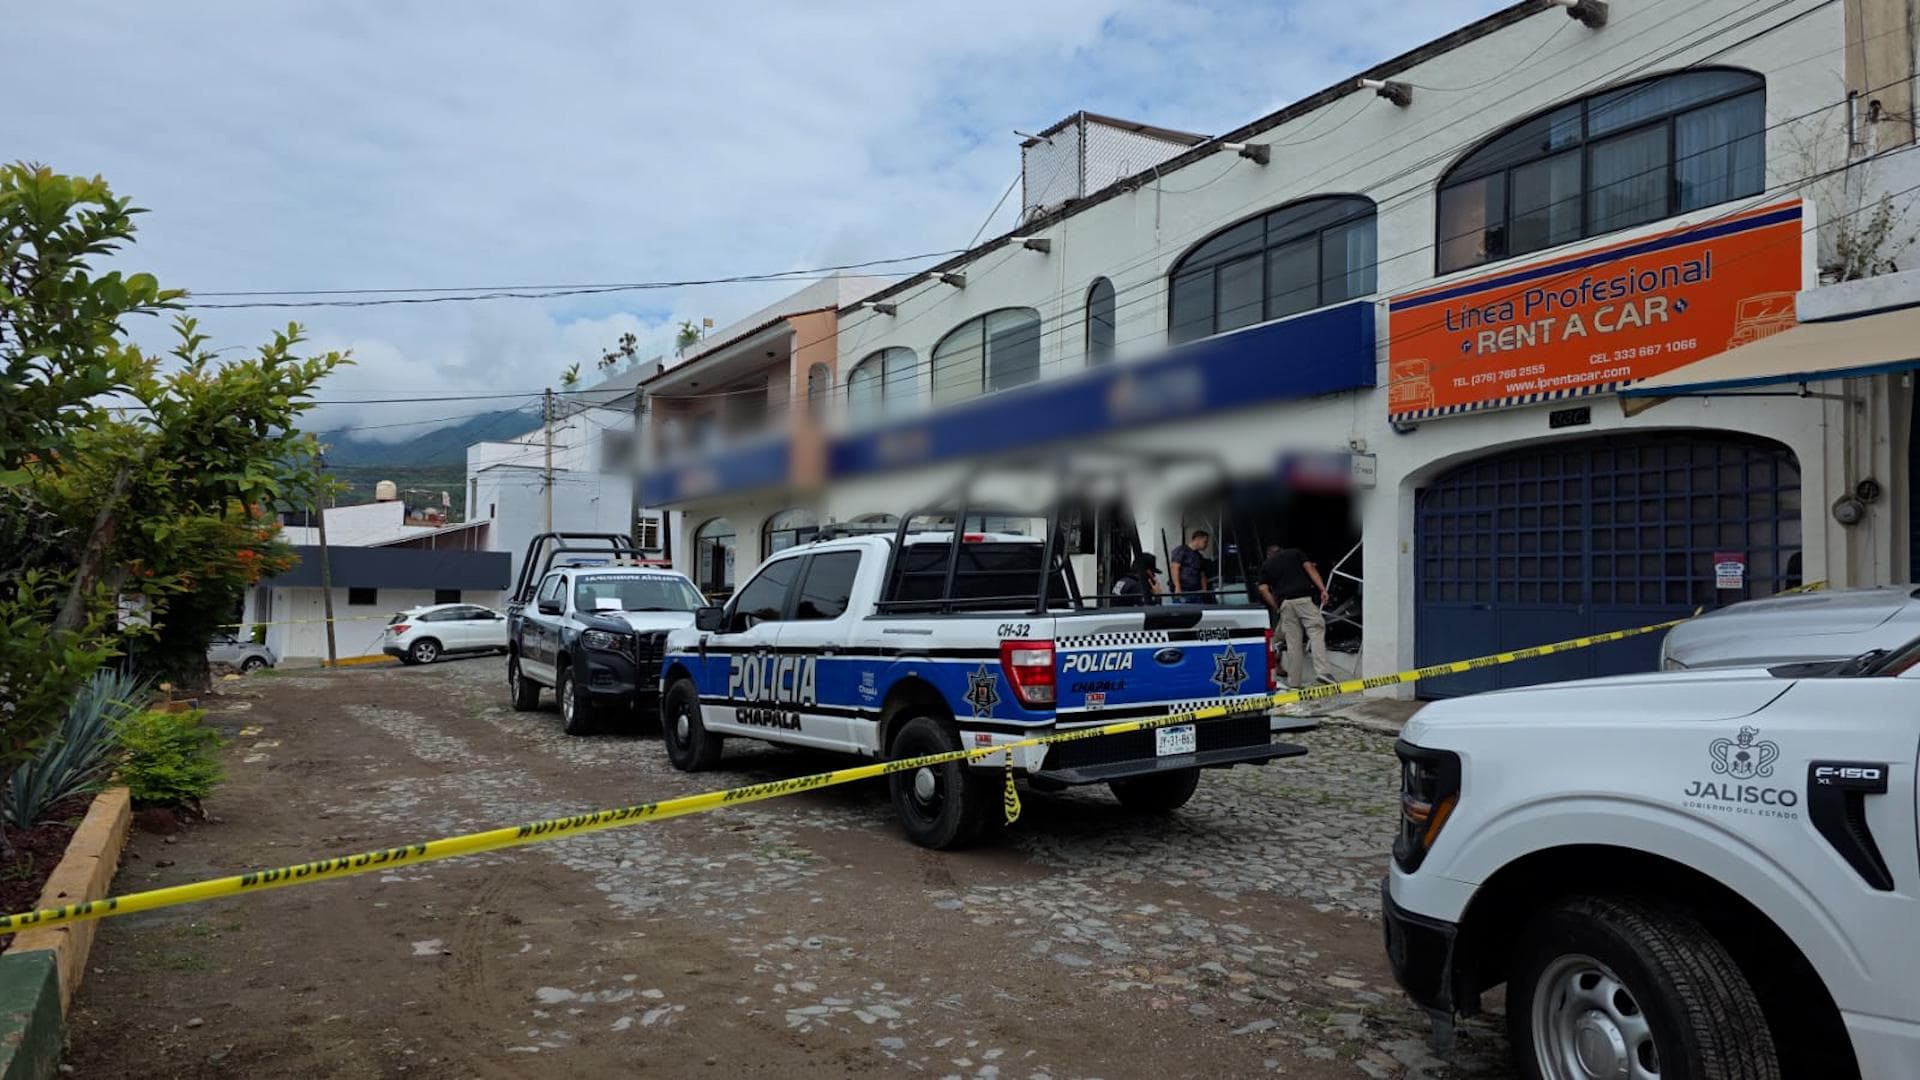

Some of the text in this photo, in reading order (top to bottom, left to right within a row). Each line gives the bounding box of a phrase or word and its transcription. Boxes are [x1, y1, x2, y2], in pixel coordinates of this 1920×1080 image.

[1523, 250, 1712, 317] Profesional
[1477, 296, 1669, 354] RENT A CAR
[1614, 348, 1636, 360] 333
[1665, 338, 1697, 352] 1066
[1519, 364, 1545, 377] 2555
[997, 623, 1031, 637] CH-32
[1062, 651, 1133, 673] POLICIA
[729, 652, 817, 706] POLICIA
[735, 707, 802, 731] CHAPALA
[1815, 767, 1881, 779] F-150
[1684, 780, 1798, 807] JALISCO
[1682, 801, 1799, 820] GOBIERNO DEL ESTADO
